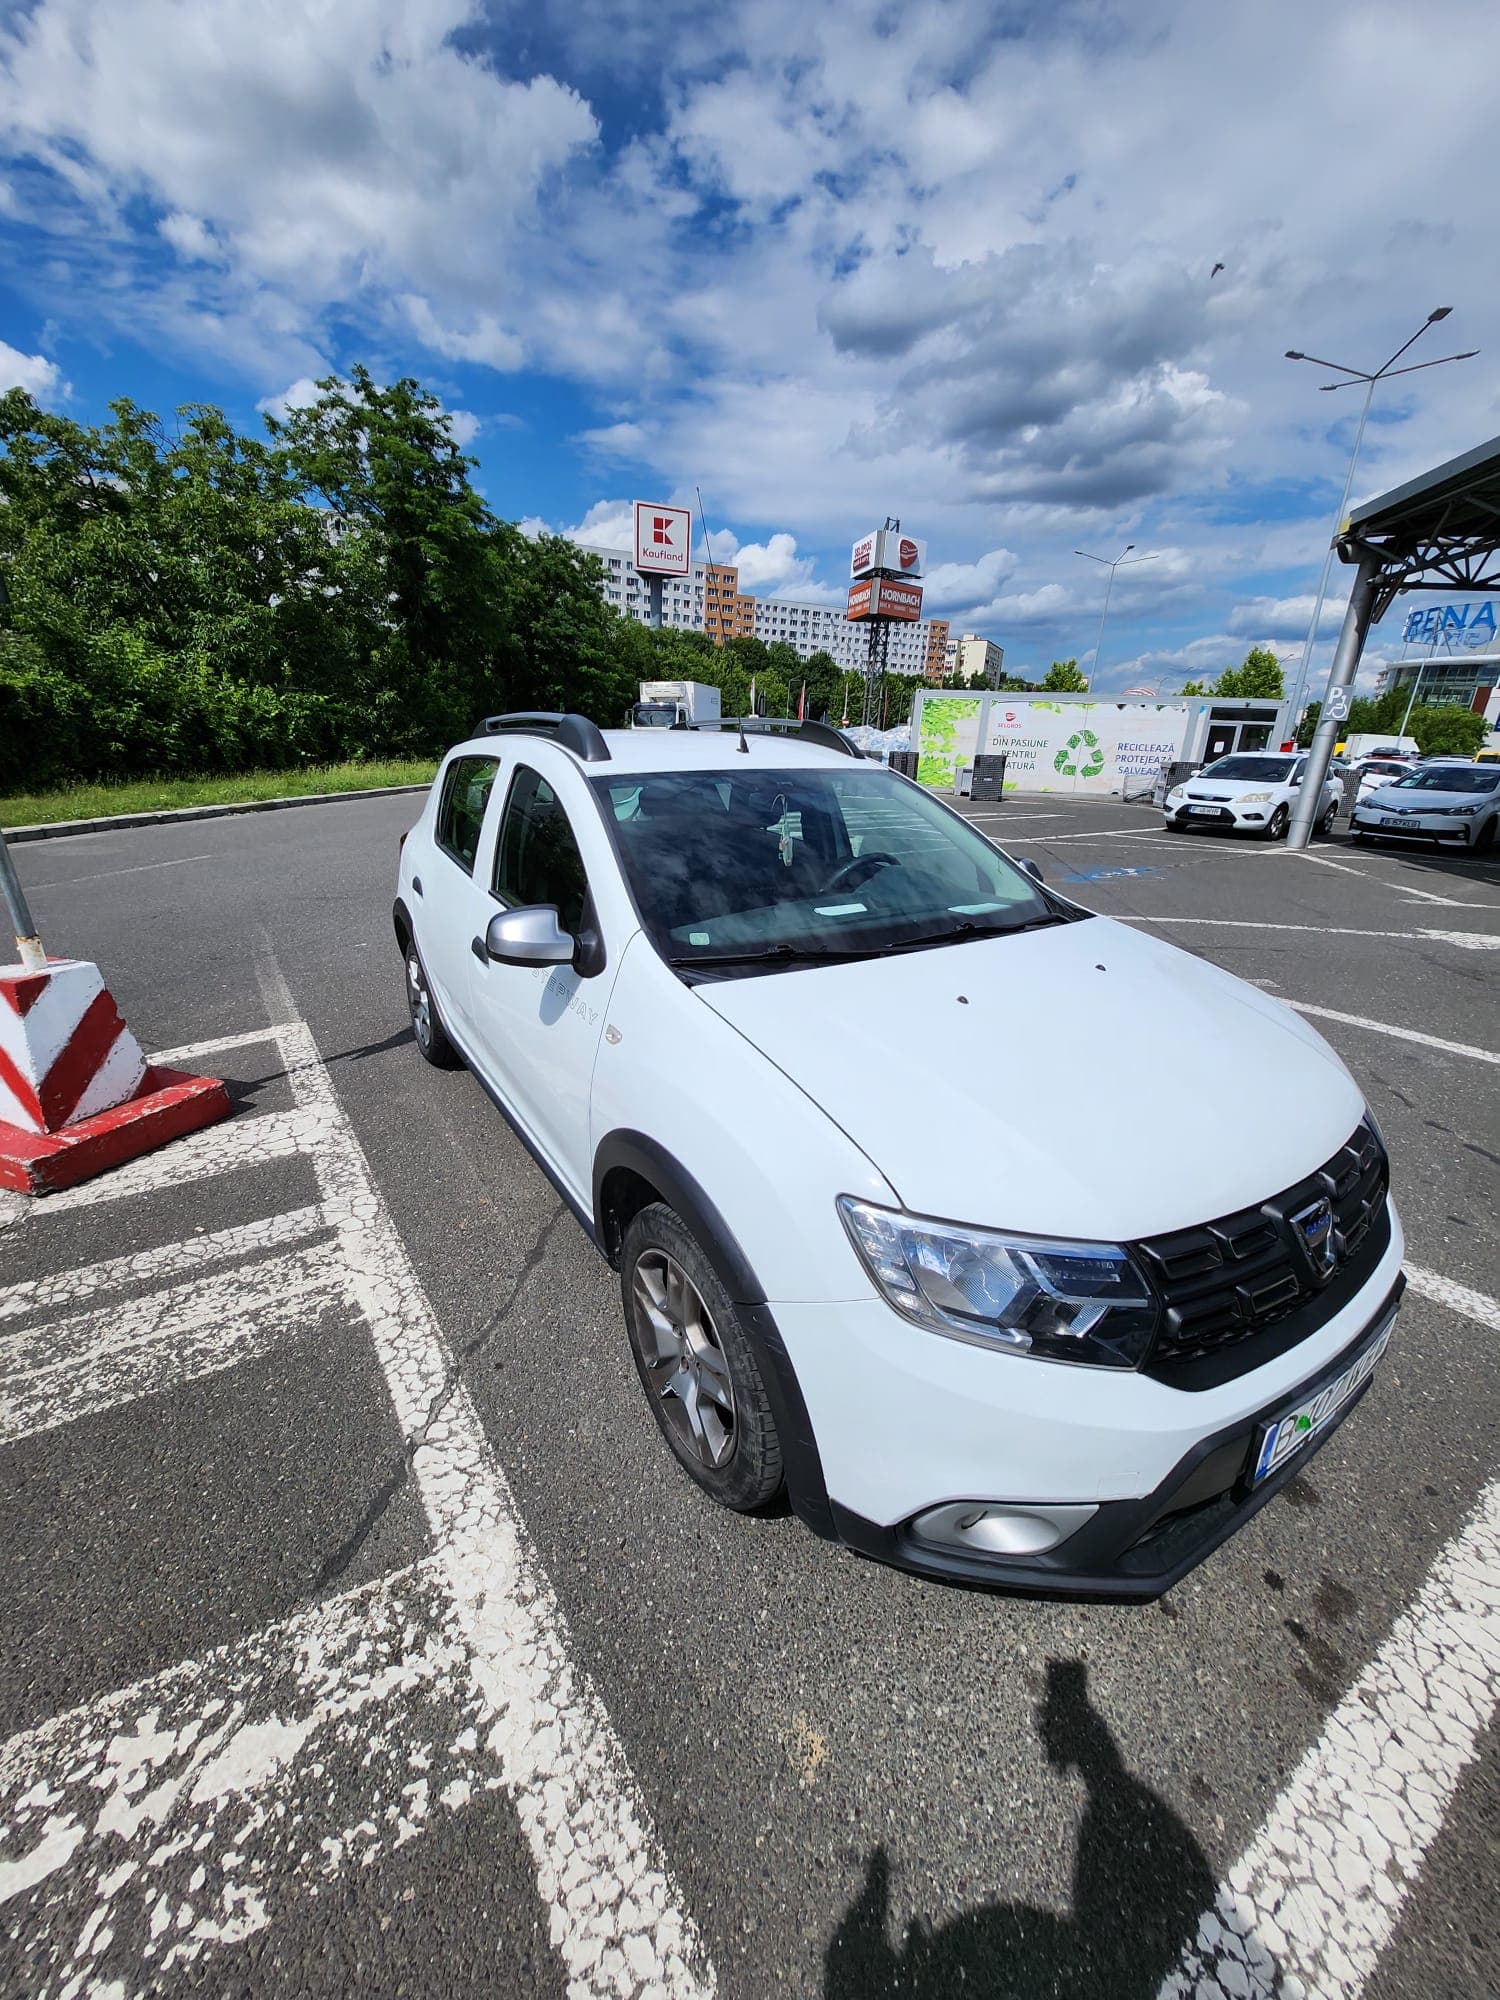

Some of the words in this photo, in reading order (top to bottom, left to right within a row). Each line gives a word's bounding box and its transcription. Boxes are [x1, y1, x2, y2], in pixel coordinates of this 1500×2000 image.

[642, 547, 684, 562] Kaufland
[881, 588, 921, 607] HORNBACH
[1328, 687, 1343, 704] P
[1010, 738, 1049, 748] PASIUNE
[1117, 743, 1175, 753] RECICLEAZĂ
[1006, 761, 1035, 770] ATURĂ
[1118, 767, 1160, 776] SALVEAZ
[1273, 1414, 1298, 1459] B
